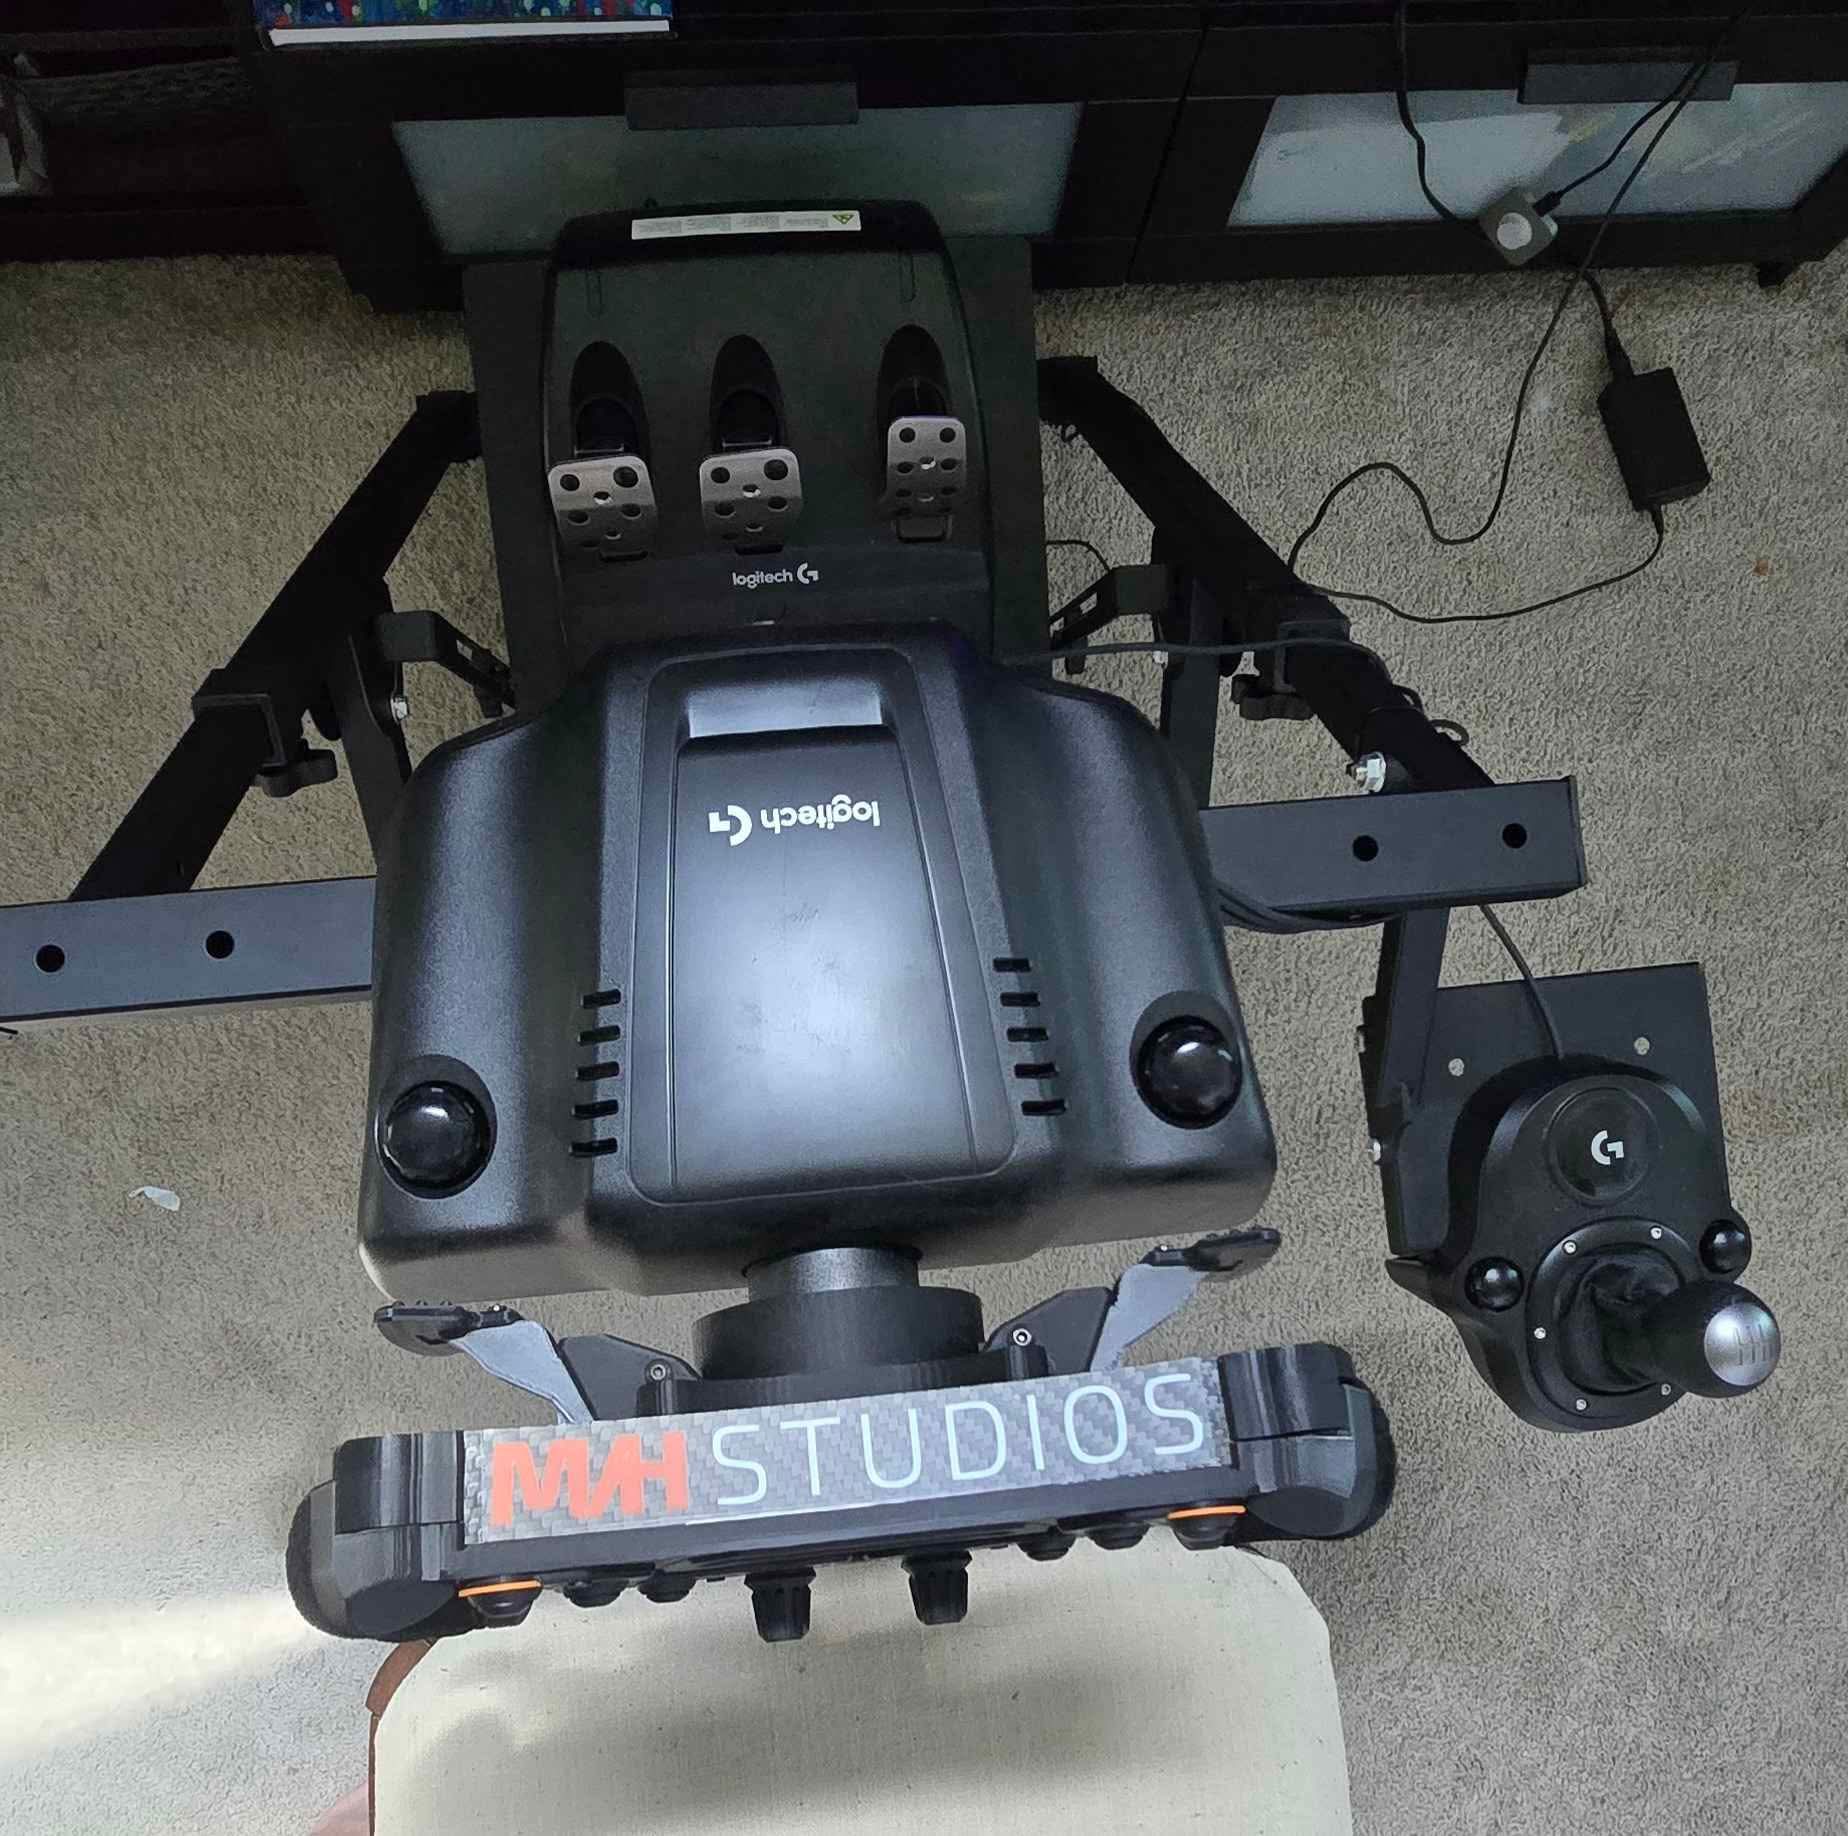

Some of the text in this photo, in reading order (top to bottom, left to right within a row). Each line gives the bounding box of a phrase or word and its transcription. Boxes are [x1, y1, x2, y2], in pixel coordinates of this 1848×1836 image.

[732, 569, 793, 589] logitech
[760, 794, 880, 834] logitech
[711, 1373, 1205, 1507] STUDIOS
